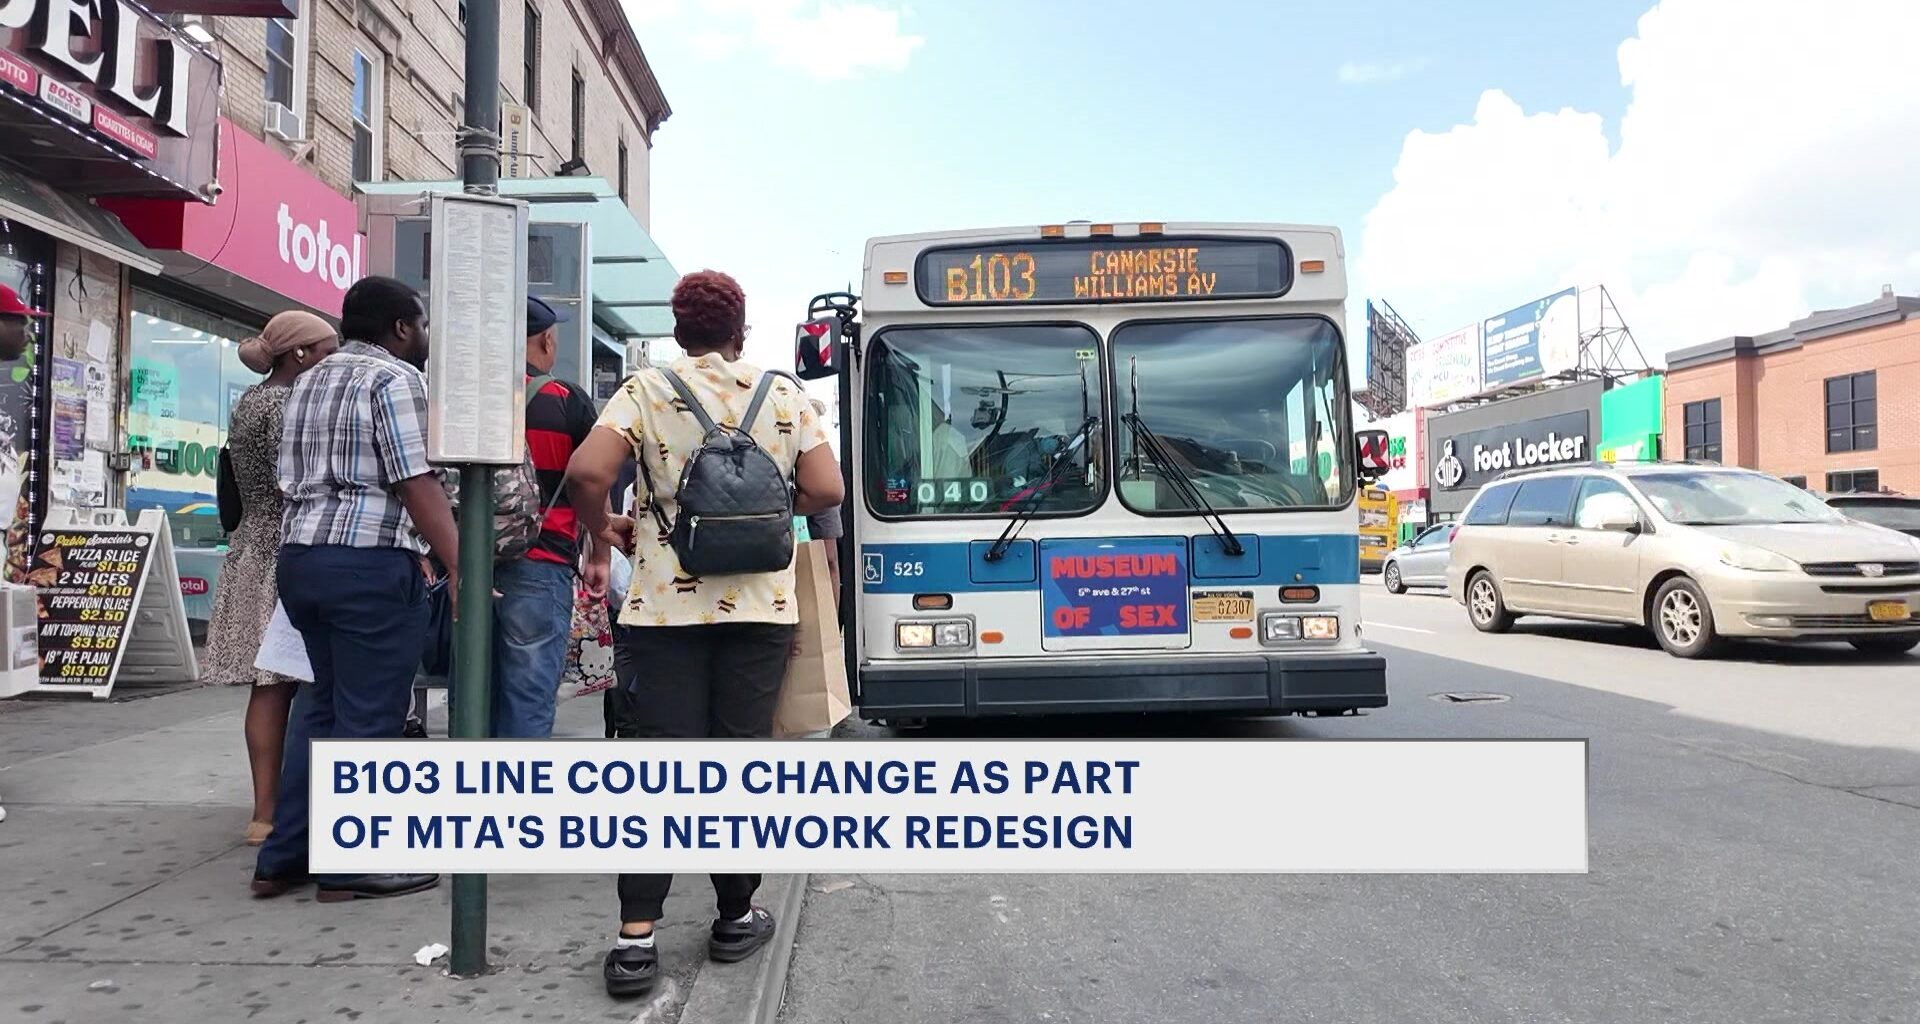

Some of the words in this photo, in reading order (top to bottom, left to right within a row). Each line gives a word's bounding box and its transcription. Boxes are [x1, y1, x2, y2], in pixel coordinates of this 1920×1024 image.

[0, 57, 29, 83] OTTO
[48, 81, 82, 107] BOSS
[277, 202, 361, 290] total
[1091, 247, 1199, 275] CANARSIE
[947, 252, 1036, 302] B103
[1074, 274, 1178, 298] WILLIAMS
[1186, 272, 1217, 296] AV
[1473, 443, 1512, 473] Foot
[1516, 432, 1585, 467] Locker
[917, 482, 988, 503] 040
[67, 548, 102, 561] PIZZA
[103, 550, 141, 563] SLICE
[97, 560, 137, 573] $1.50
[894, 561, 924, 577] 525
[1051, 554, 1177, 579] MUSEUM
[58, 572, 71, 585] 2
[72, 572, 129, 586] SLICES
[180, 580, 204, 591] otal
[87, 584, 133, 597] $4.00
[1092, 588, 1110, 596] ave
[1111, 587, 1120, 596] &
[1120, 586, 1140, 597] 27th
[1141, 587, 1151, 595] st
[50, 595, 102, 610] PEPPERONI
[102, 597, 132, 611] SLICE
[80, 609, 125, 622] $2.50
[1053, 606, 1090, 629] OF
[1119, 604, 1178, 628] SEX
[40, 623, 60, 637] ANY
[60, 623, 96, 638] TOPPING
[95, 625, 122, 639] SLICE
[71, 636, 117, 649] $3.50
[61, 651, 80, 664] PIE
[79, 651, 112, 666] PLAIN
[61, 663, 109, 677] $13.00
